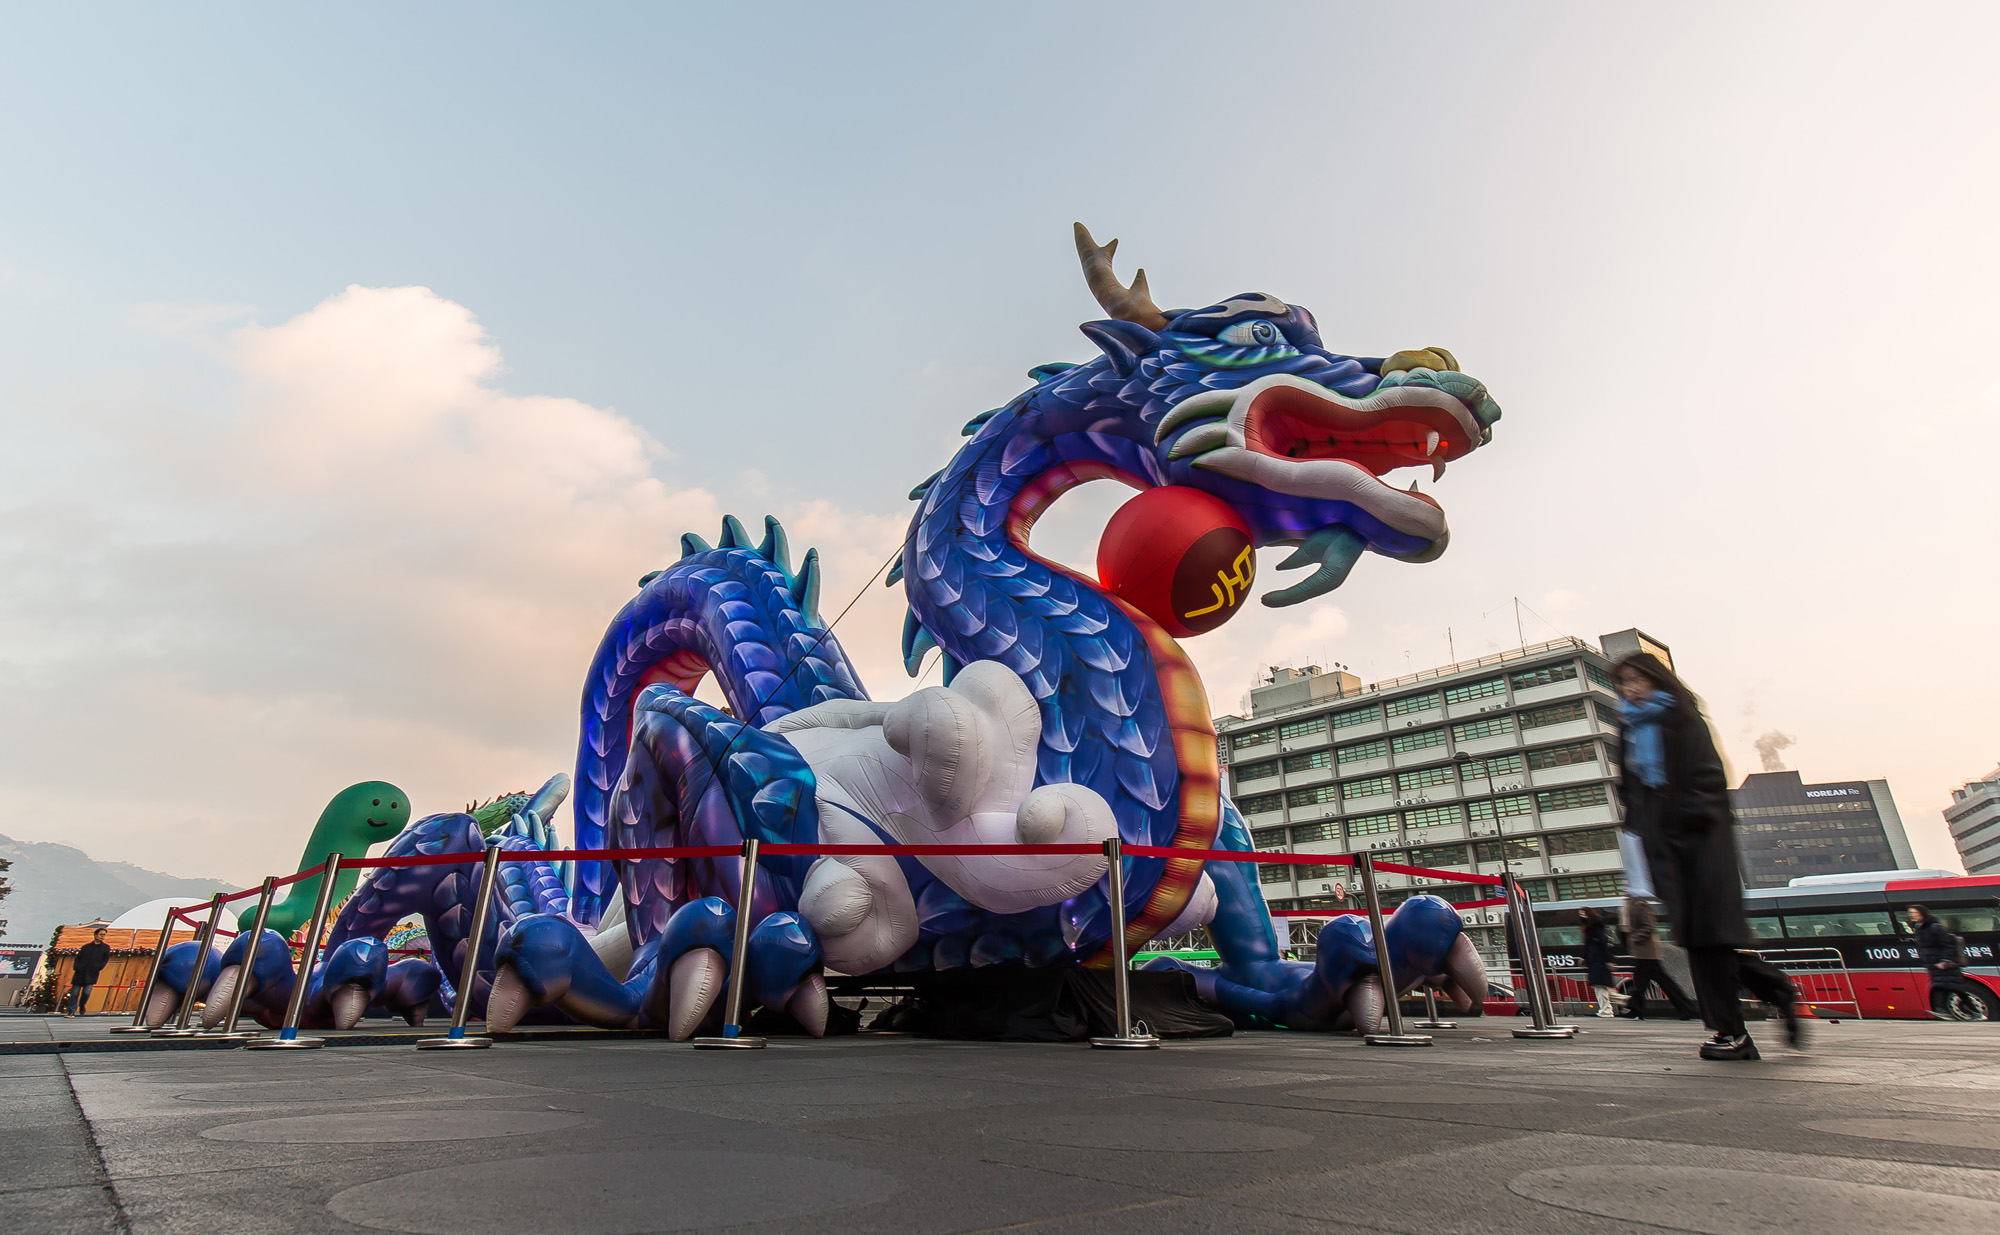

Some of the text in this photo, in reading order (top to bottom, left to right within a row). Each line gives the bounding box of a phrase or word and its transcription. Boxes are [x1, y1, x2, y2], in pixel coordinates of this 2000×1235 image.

[1806, 788, 1848, 798] KOREAN
[1865, 948, 1900, 959] 1000
[1546, 954, 1575, 967] BUS
